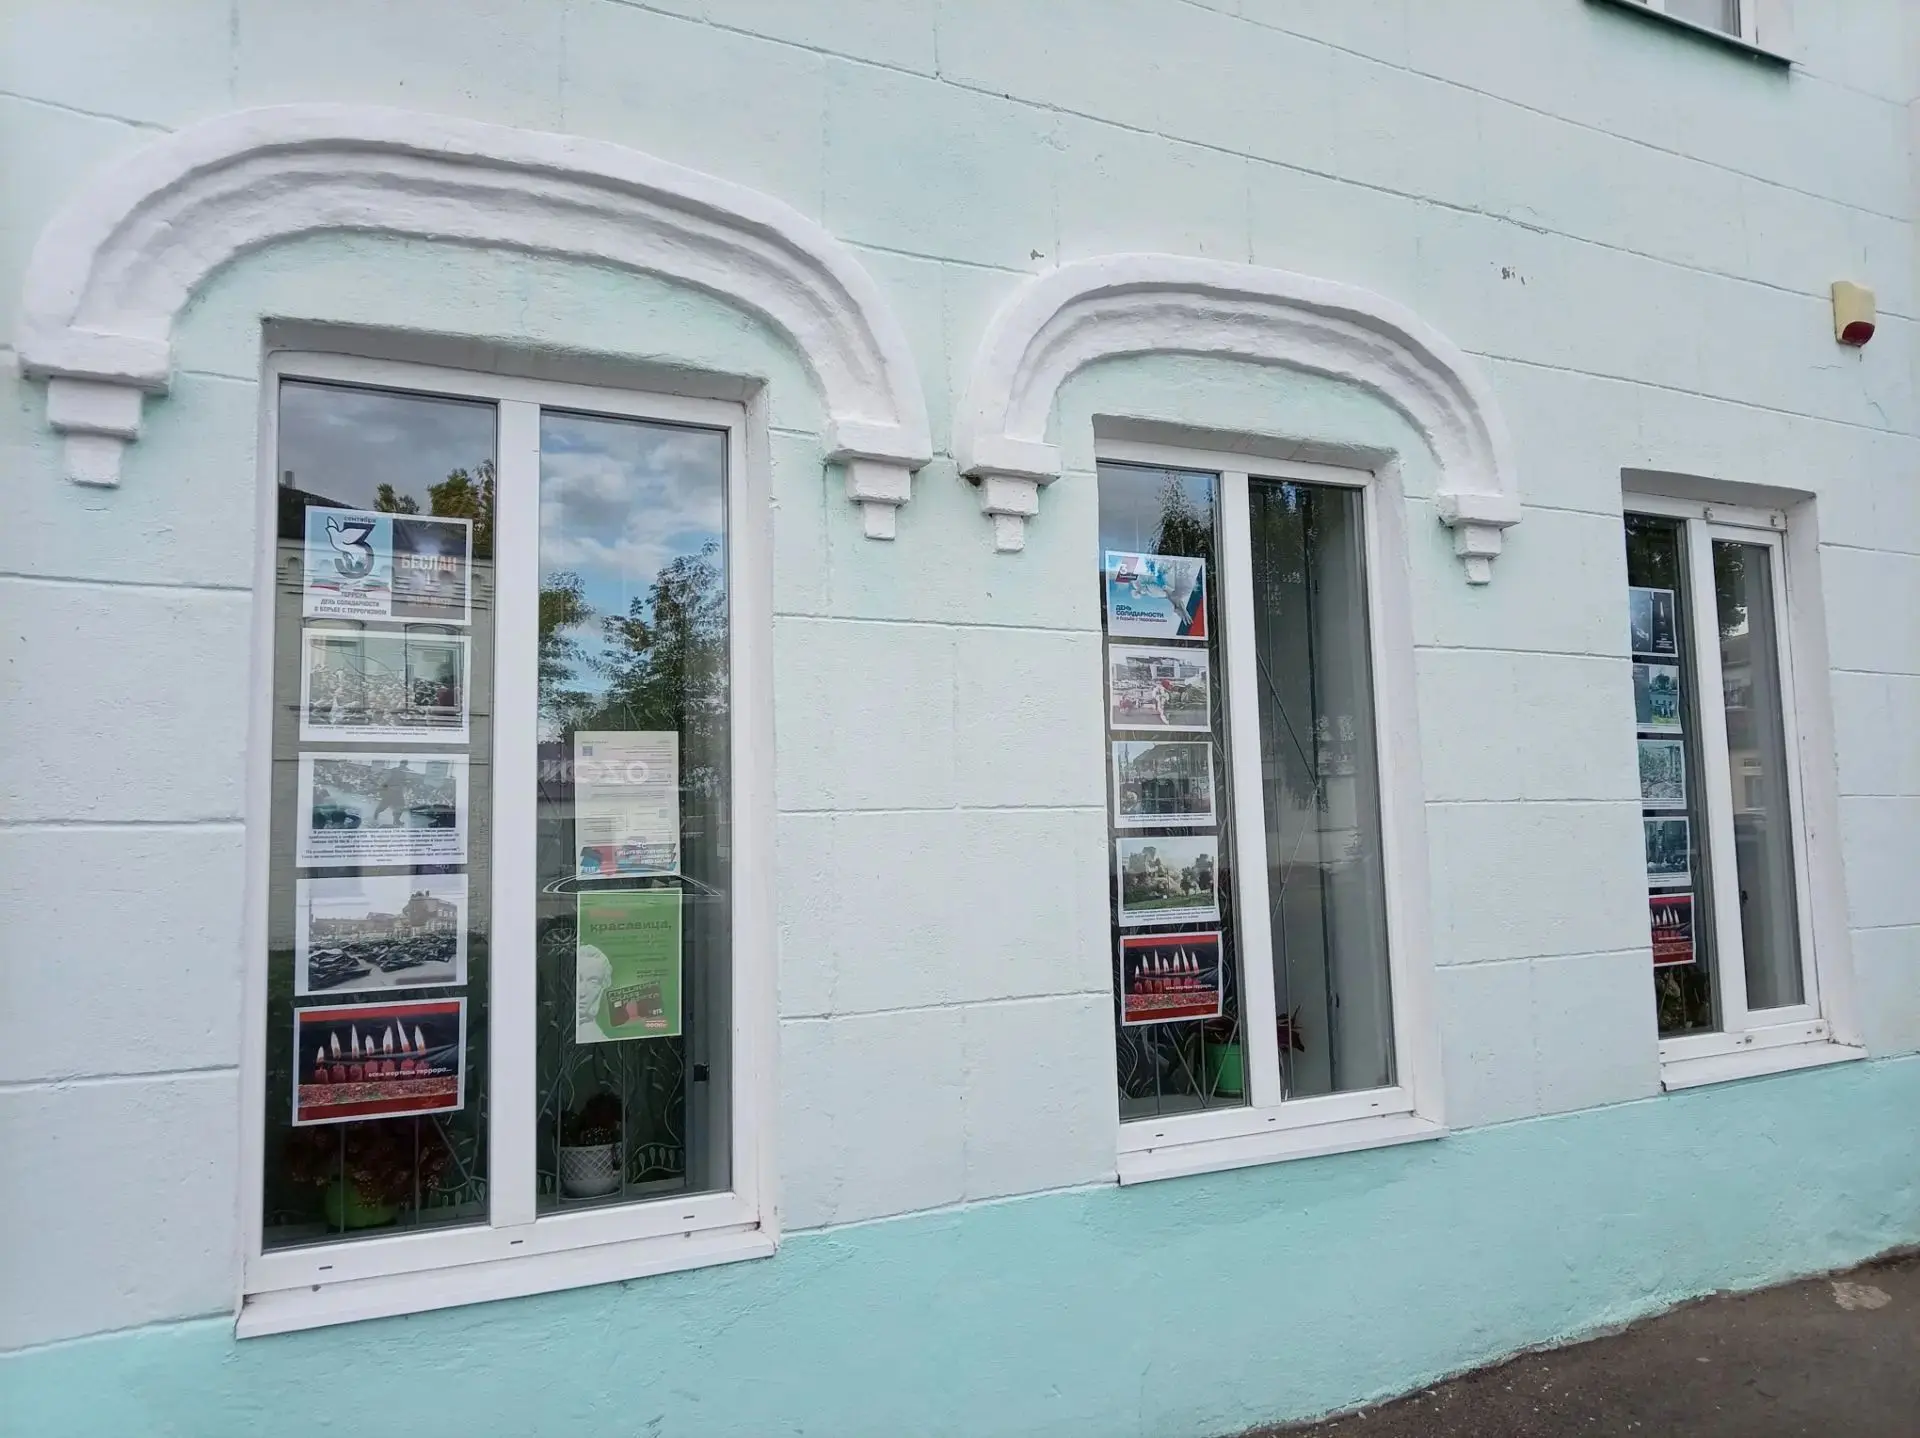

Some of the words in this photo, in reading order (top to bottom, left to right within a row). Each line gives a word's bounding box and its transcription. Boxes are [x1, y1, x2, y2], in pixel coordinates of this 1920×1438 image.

[401, 553, 457, 572] БЕСЛАН
[1116, 610, 1164, 618] СОЛИДАРНОСТИ
[590, 919, 672, 935] красавица,
